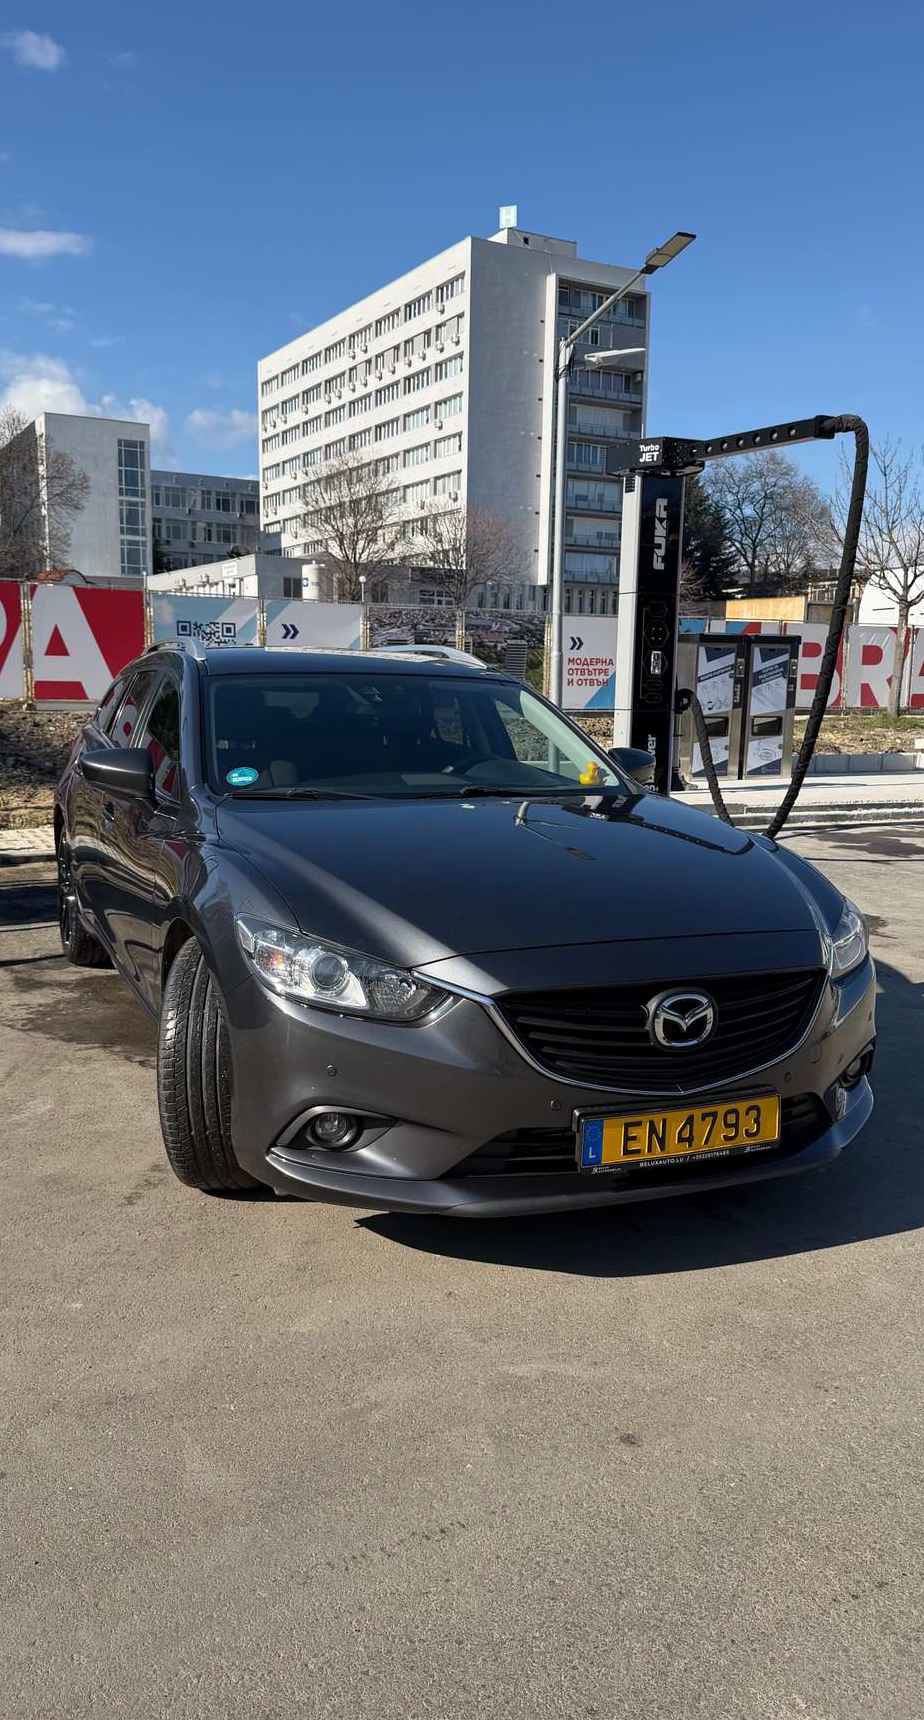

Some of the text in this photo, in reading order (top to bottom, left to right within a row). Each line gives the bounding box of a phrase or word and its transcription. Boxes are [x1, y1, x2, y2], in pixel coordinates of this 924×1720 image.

[640, 444, 660, 453] Turbo
[639, 452, 660, 463] JET
[653, 498, 668, 571] FUKA
[0, 584, 116, 700] A
[567, 657, 615, 667] МОДЕРНА
[567, 667, 610, 677] ОТВЪТРЕ
[567, 678, 609, 687] И ОТВЪН
[588, 1147, 597, 1159] L
